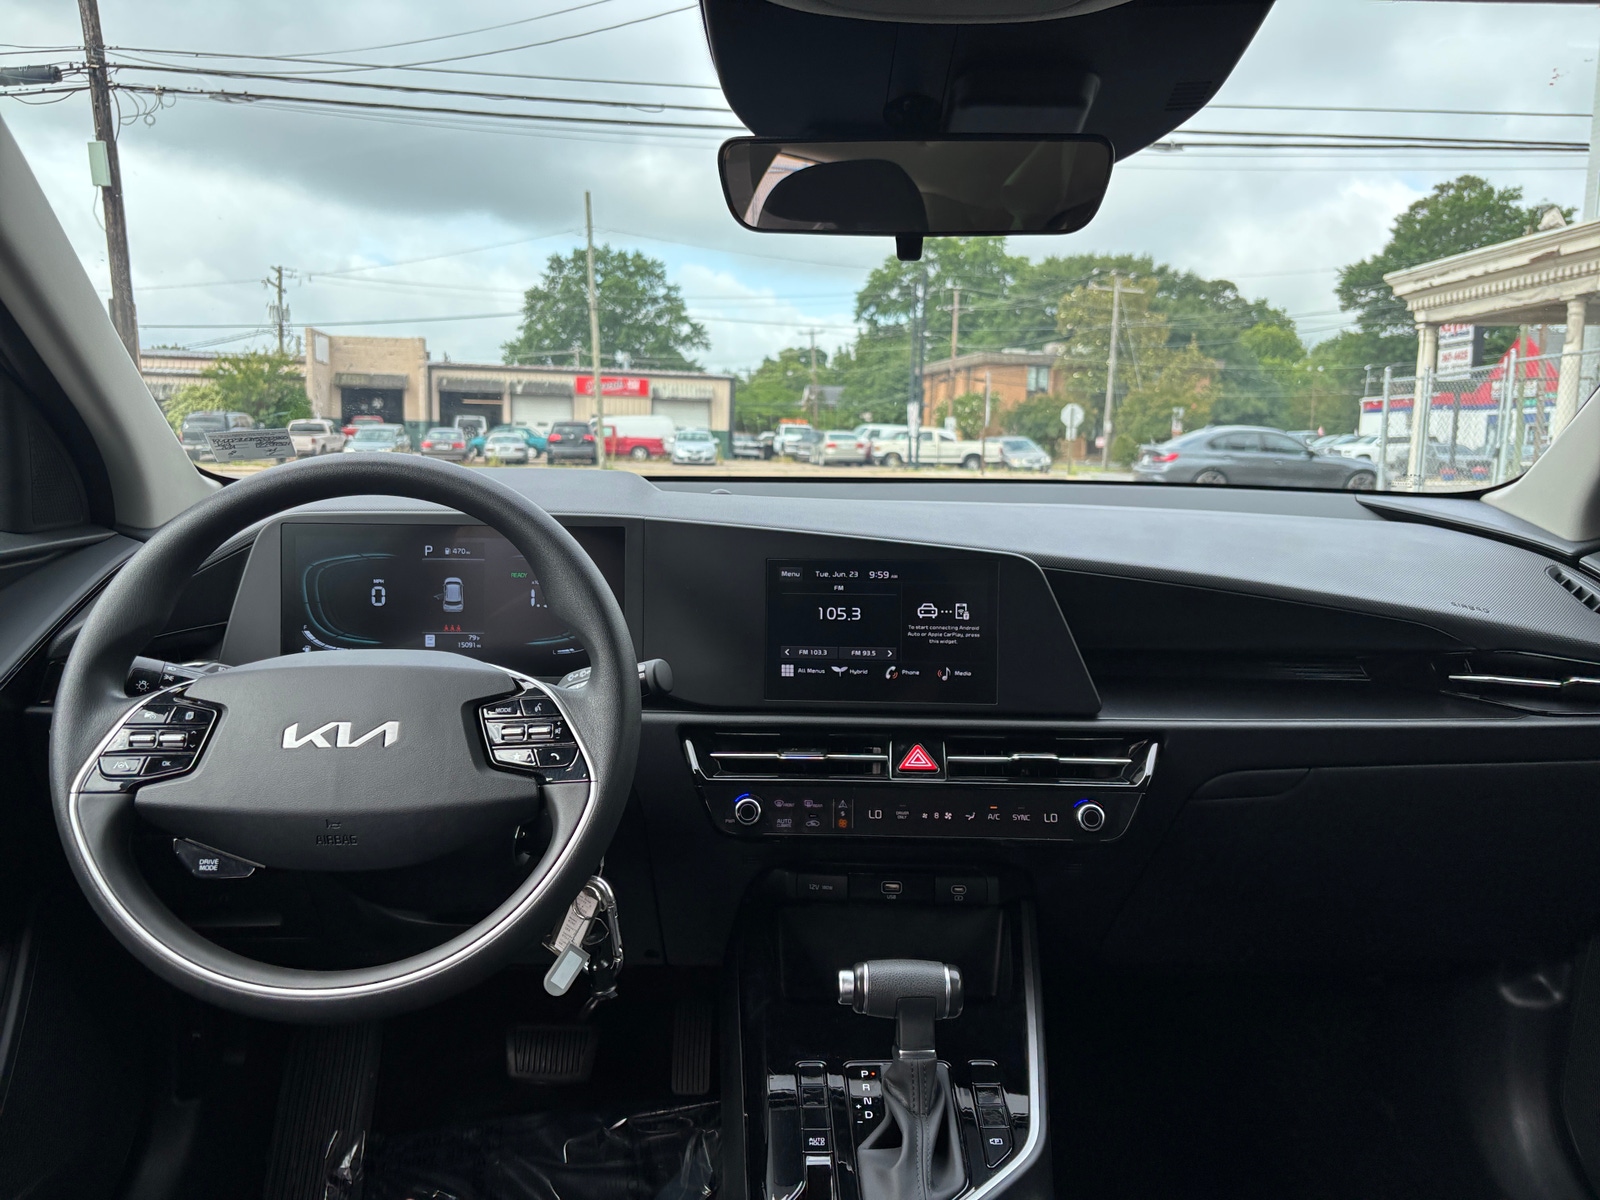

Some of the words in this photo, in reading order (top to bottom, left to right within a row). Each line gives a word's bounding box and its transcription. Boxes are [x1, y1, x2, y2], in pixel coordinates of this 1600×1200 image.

[424, 544, 434, 557] P
[815, 570, 831, 578] Tue.
[832, 570, 848, 578] Jun.
[849, 570, 859, 578] 23
[869, 571, 890, 579] 9:59
[371, 586, 386, 607] 0
[818, 606, 862, 621] 105.3
[798, 648, 809, 656] FM
[810, 648, 828, 656] 103.3
[851, 649, 861, 657] FM
[495, 706, 512, 714] MODE
[281, 721, 400, 749] KIA
[868, 809, 883, 820] LO
[987, 813, 1000, 821] A/C
[1012, 813, 1031, 821] SYNC
[1043, 813, 1058, 823] LO
[316, 835, 358, 846] AIRBAG
[860, 1070, 869, 1078] P
[862, 1083, 870, 1091] R
[863, 1097, 873, 1105] N
[864, 1110, 874, 1119] D
